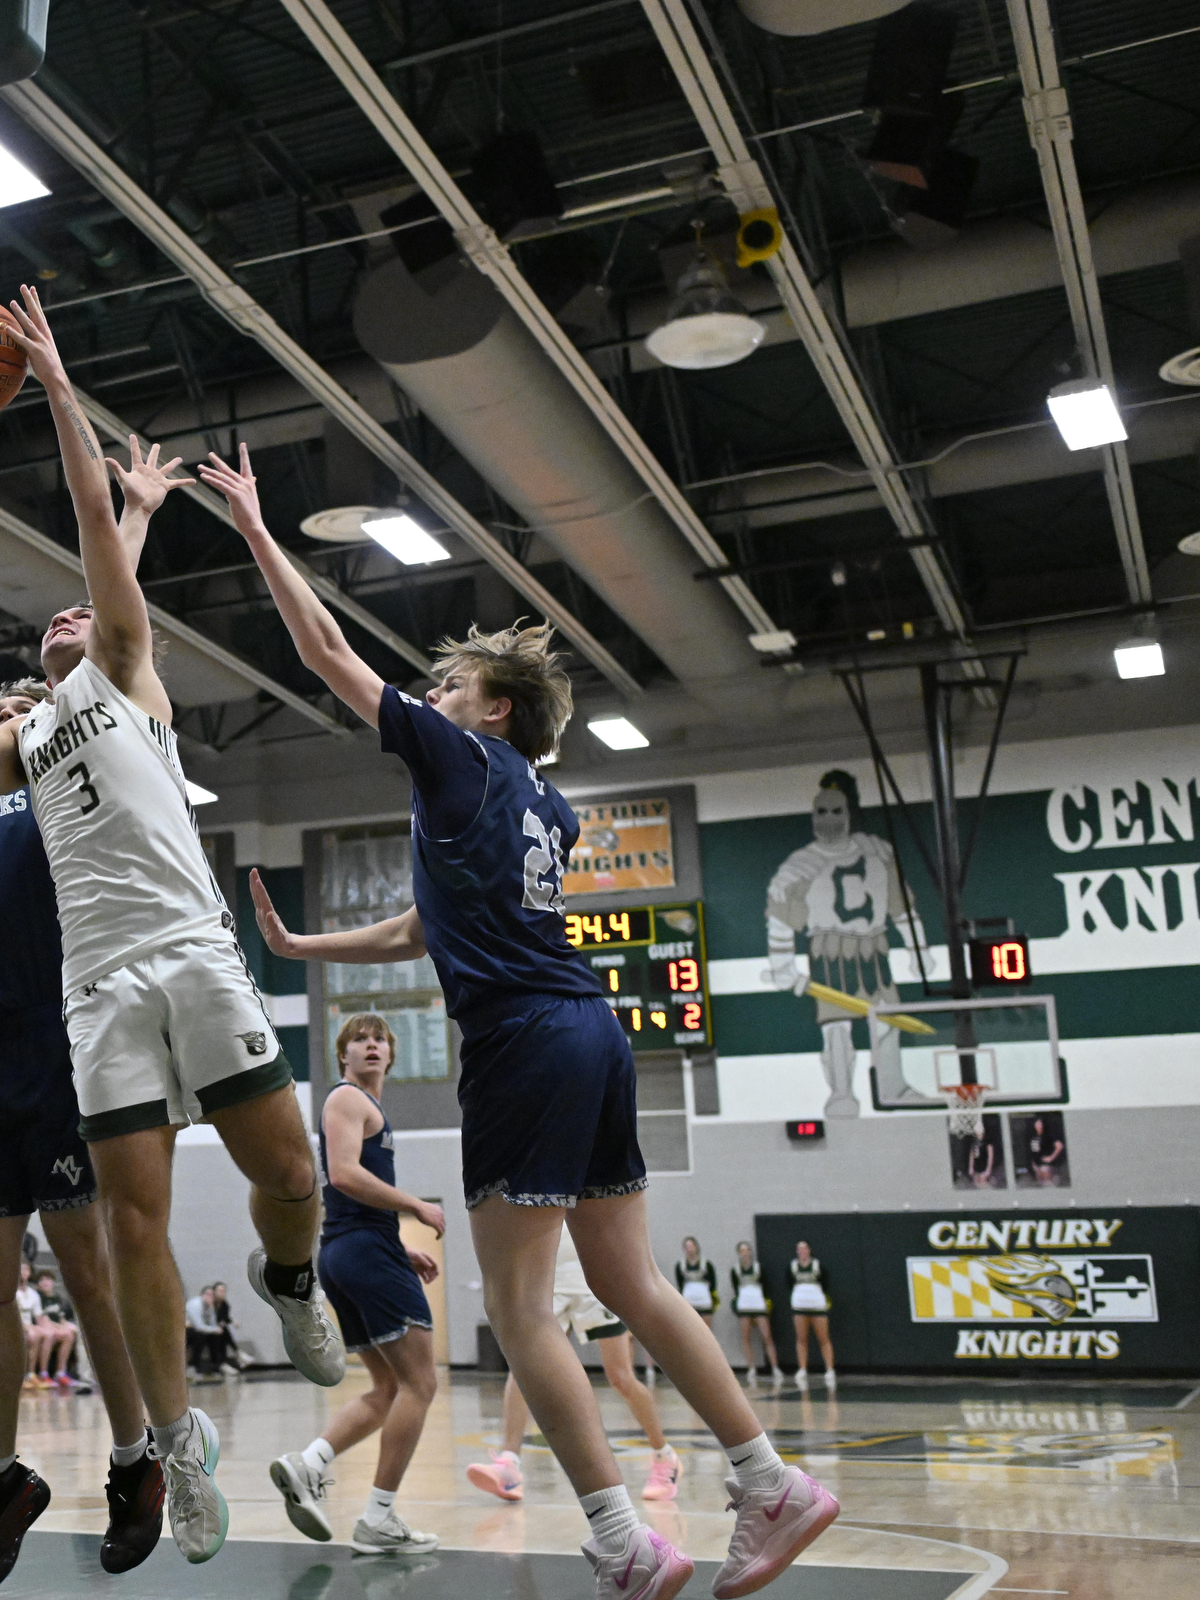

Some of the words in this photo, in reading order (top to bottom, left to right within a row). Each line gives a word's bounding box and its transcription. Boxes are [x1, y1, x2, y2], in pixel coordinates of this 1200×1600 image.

[28, 701, 118, 785] KNIGHTS
[67, 761, 100, 816] 3
[1046, 777, 1200, 853] CEN
[568, 850, 668, 873] NIGHTS
[832, 855, 874, 925] C
[565, 913, 630, 946] 34.4
[648, 941, 694, 960] GUEST
[992, 943, 1025, 979] 10
[609, 969, 619, 992] 1
[668, 958, 699, 992] 13
[684, 1003, 701, 1029] 2
[927, 1219, 1122, 1251] CENTURY
[954, 1330, 1120, 1360] KNIGHTS
